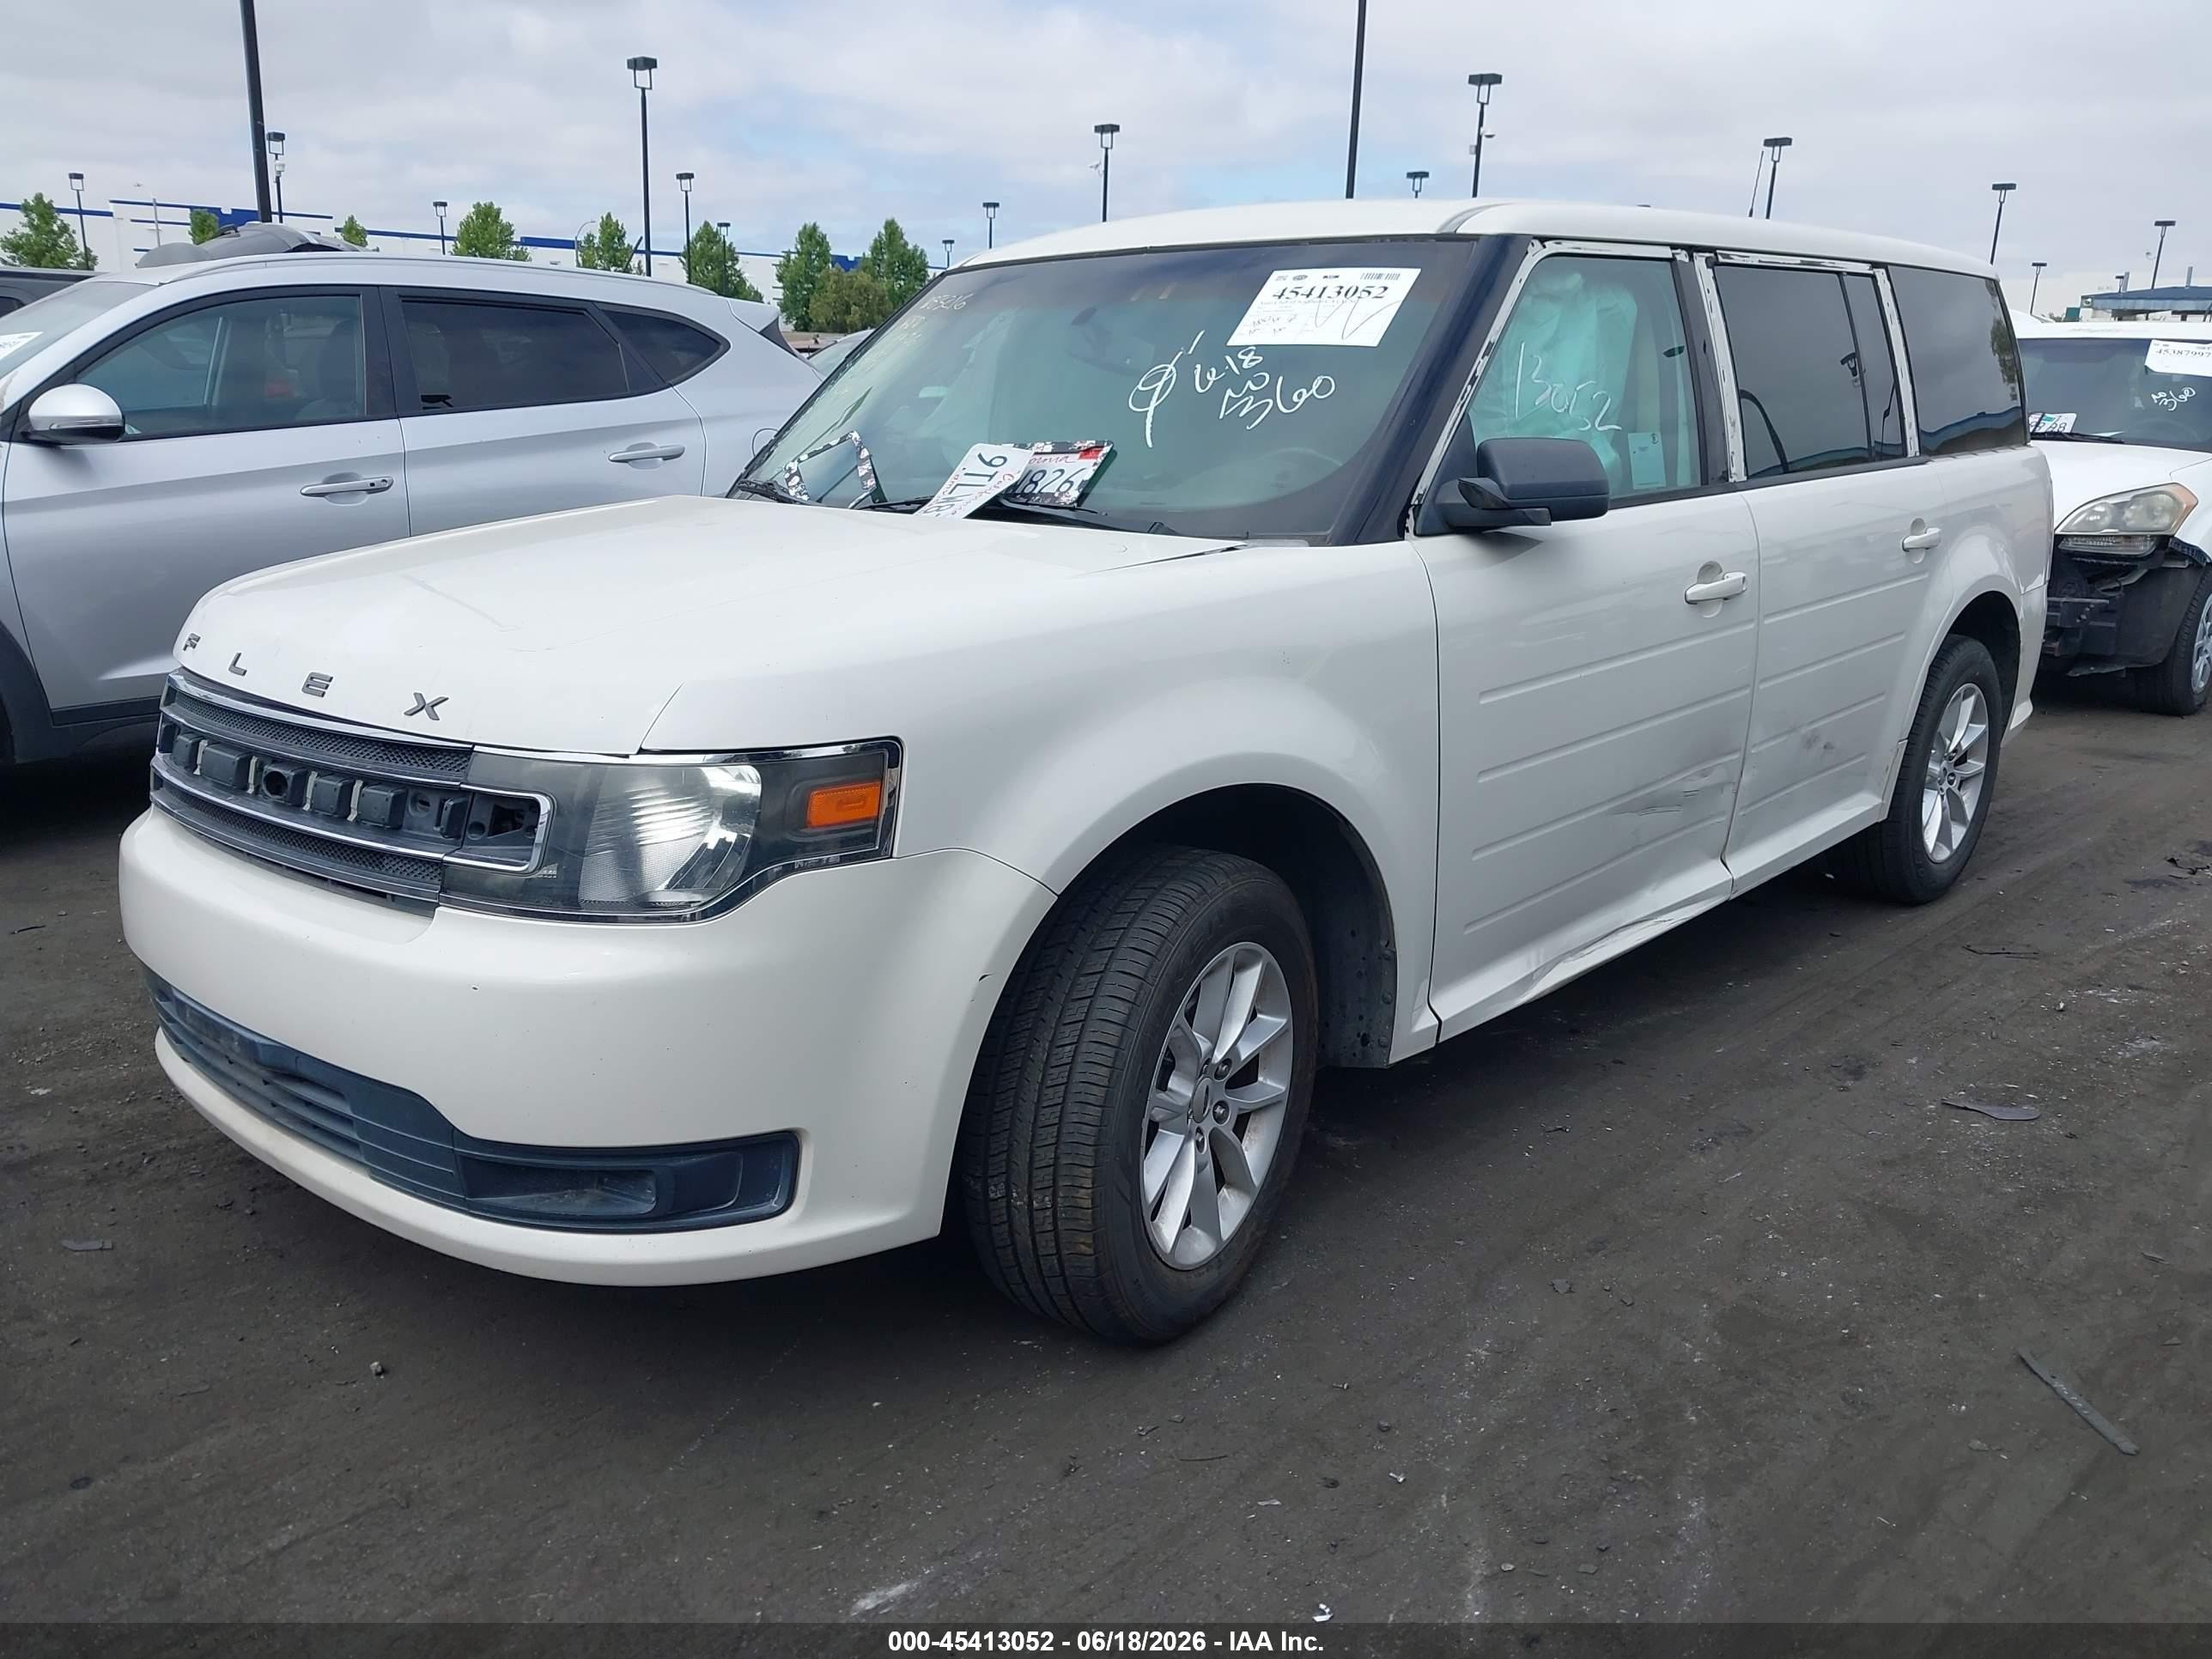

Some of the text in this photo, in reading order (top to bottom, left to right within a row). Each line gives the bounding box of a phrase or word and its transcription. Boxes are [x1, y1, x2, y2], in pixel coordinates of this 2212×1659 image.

[1272, 285, 1389, 300] 45413052
[1515, 341, 1622, 431] 13052
[182, 632, 450, 721] FLEX
